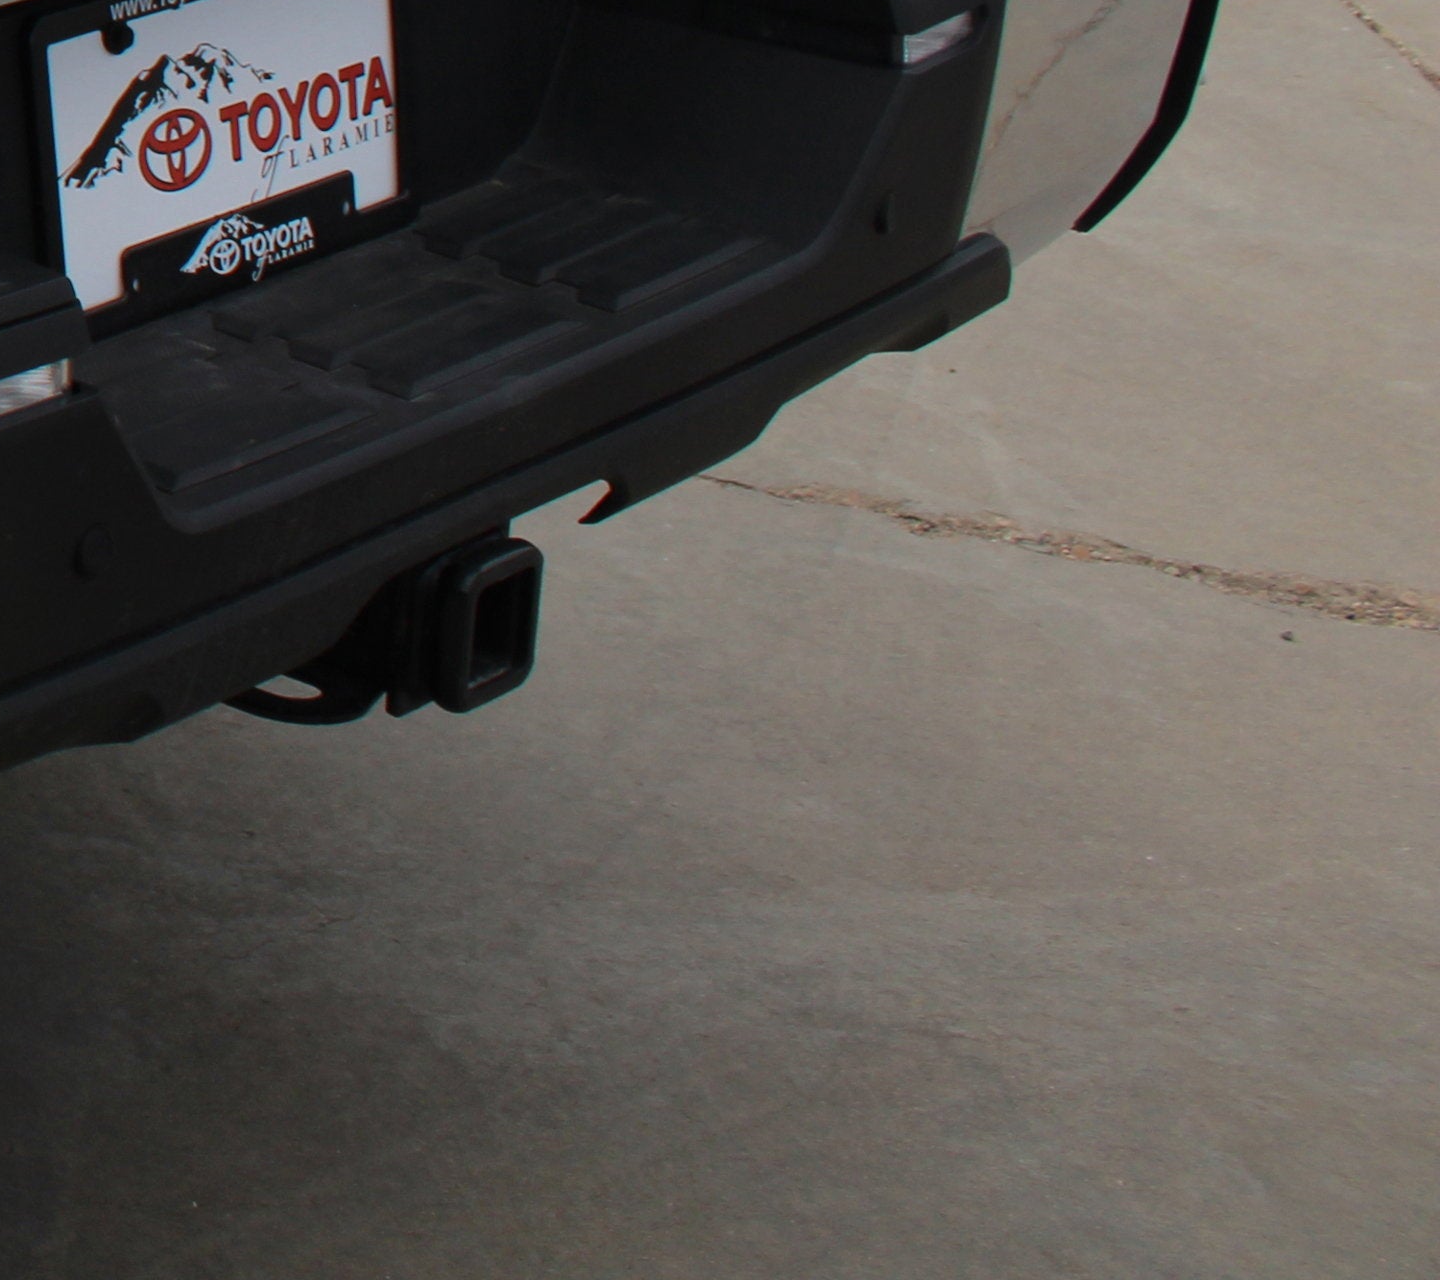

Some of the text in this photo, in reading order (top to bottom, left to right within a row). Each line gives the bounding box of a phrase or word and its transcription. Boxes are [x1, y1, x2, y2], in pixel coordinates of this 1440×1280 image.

[219, 55, 394, 163] TOYOTA
[289, 112, 396, 169] LARAMIE
[241, 216, 315, 261] TOYOTA
[267, 239, 316, 266] LARAMIE
